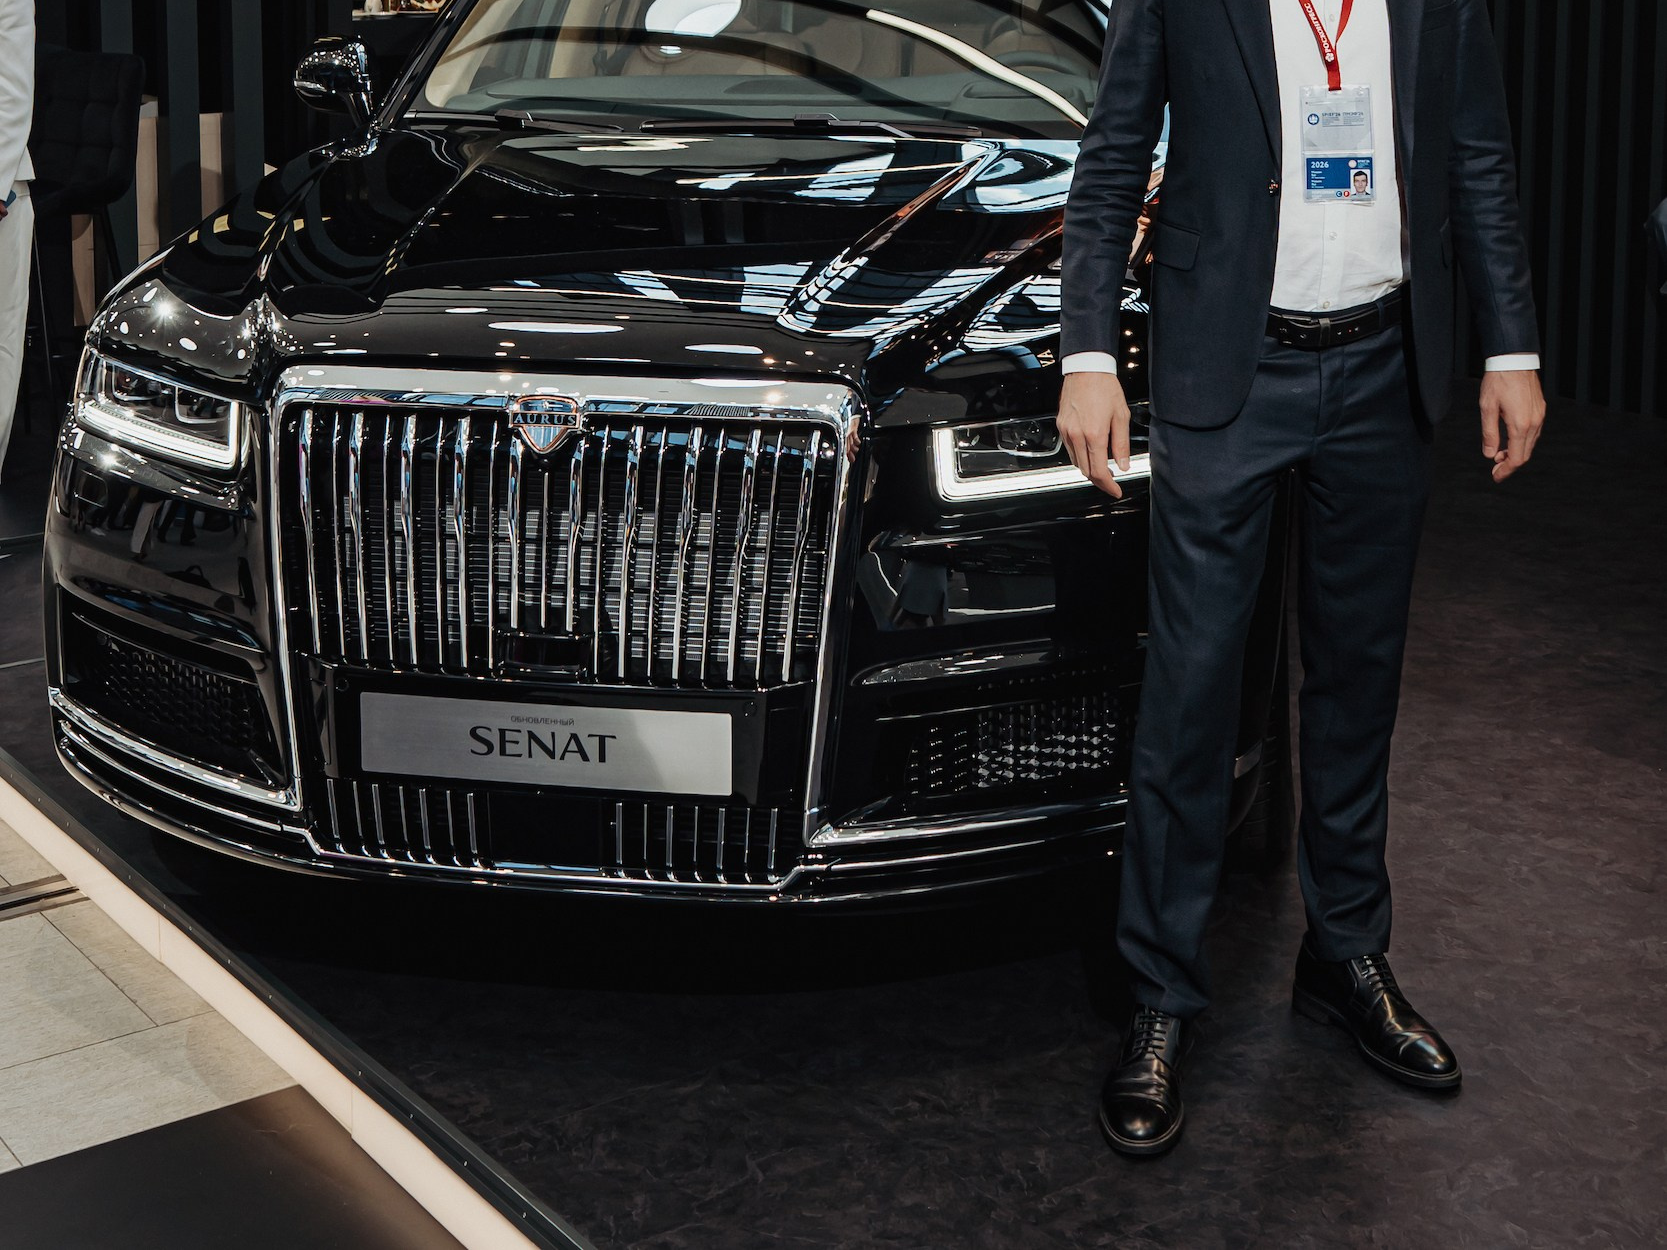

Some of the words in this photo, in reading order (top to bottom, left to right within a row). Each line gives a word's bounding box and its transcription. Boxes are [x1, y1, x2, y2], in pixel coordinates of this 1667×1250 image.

[1304, 2, 1331, 53] РОСКОНГРЕСС
[1311, 161, 1329, 169] 2026
[513, 413, 576, 425] AURUS
[510, 715, 575, 726] ОБНОВЛЕННЫЙ
[468, 725, 617, 764] SENAT
